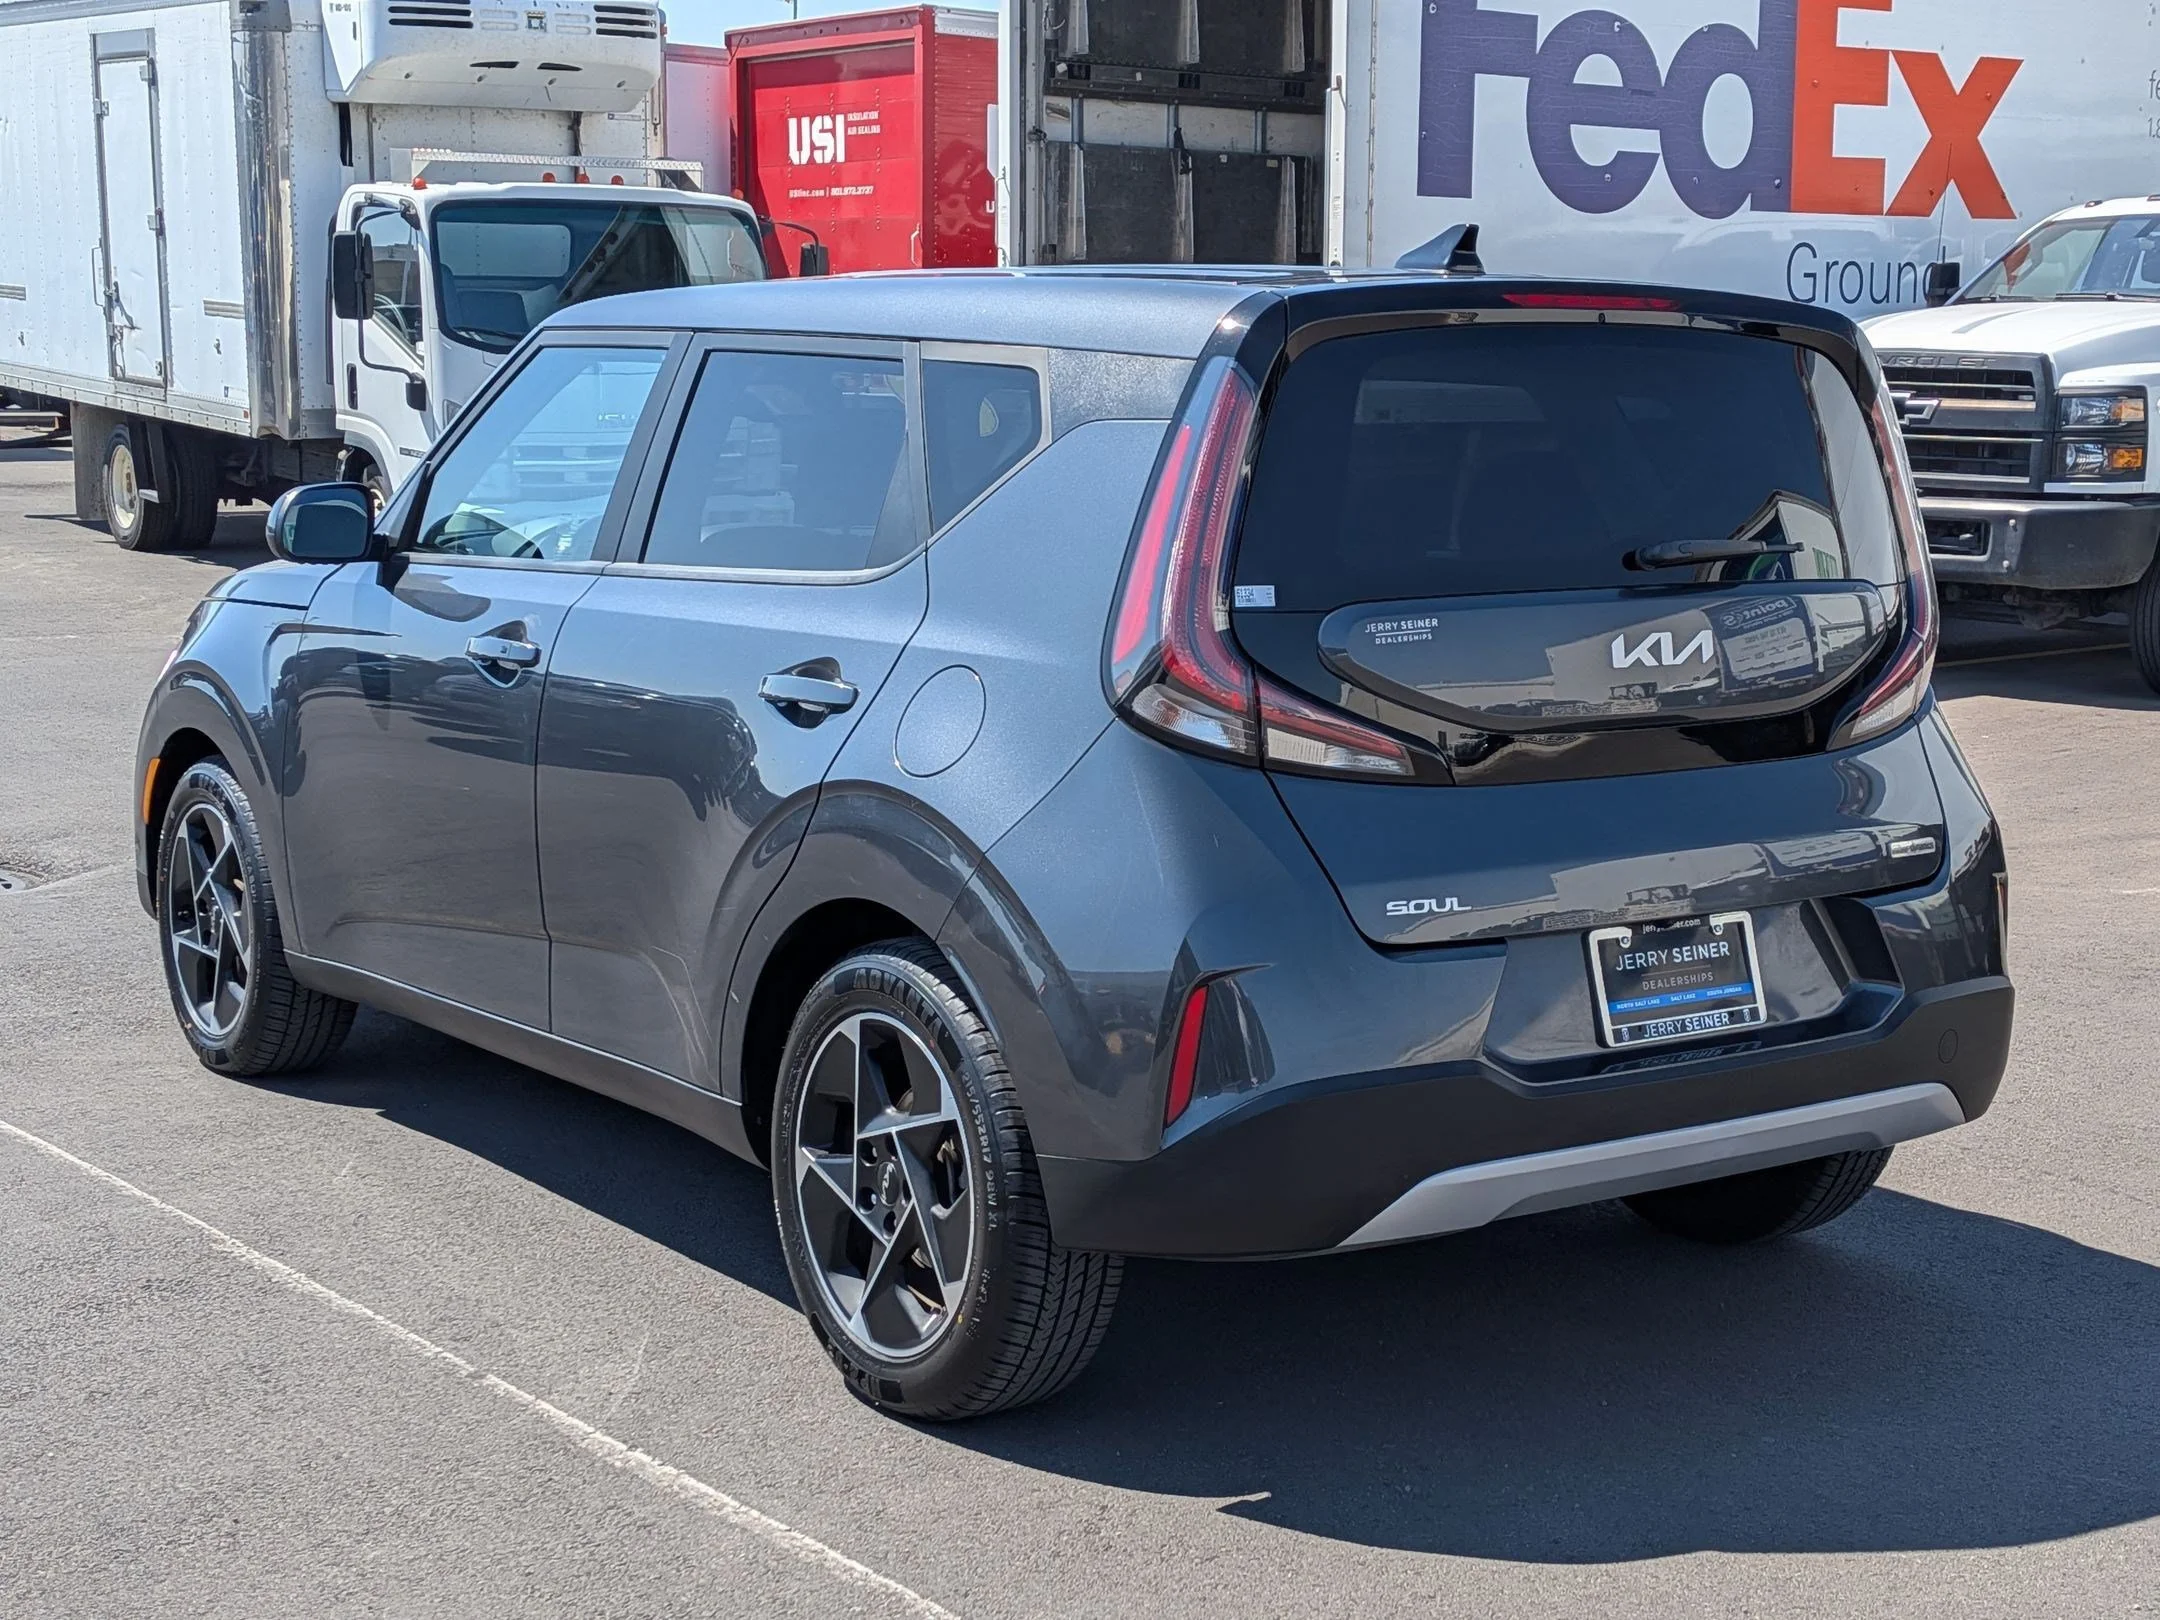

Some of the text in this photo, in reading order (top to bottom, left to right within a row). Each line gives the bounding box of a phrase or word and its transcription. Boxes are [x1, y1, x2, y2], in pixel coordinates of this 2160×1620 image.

[1416, 0, 2024, 219] FedEx
[788, 114, 845, 165] USI
[1364, 618, 1439, 633] JERRY SEINER
[1375, 633, 1433, 645] DEALERSHIPS
[1611, 629, 1715, 669] KIA
[1386, 897, 1472, 916] SOUL
[1616, 941, 1731, 971] JERRY SEINER
[1642, 971, 1714, 991] DEALERSHIPS
[1670, 994, 1683, 1002] SALT
[1643, 1012, 1731, 1038] JERRY SEINER
